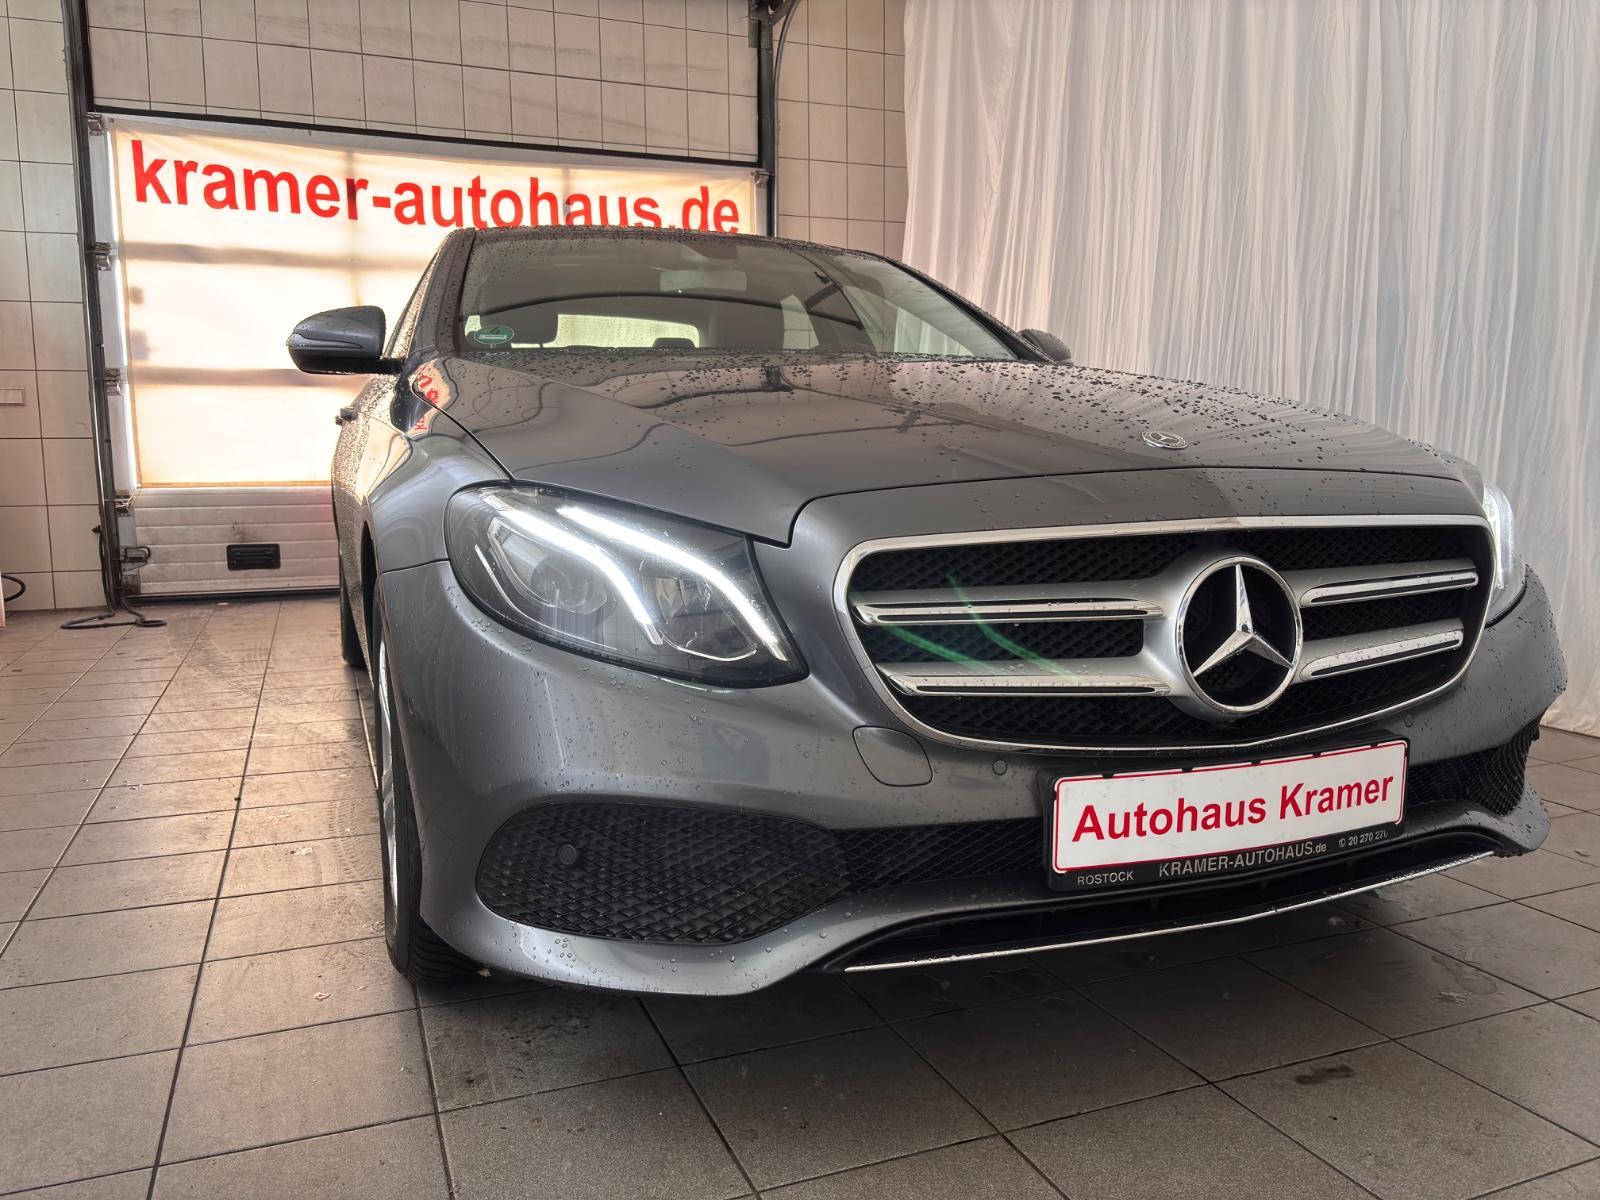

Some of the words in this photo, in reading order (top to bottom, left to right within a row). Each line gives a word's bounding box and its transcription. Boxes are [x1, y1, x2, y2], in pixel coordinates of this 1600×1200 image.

[131, 139, 739, 234] kramer-autohaus.de
[1072, 797, 1266, 843] Autohaus
[1279, 775, 1394, 820] Kramer
[1077, 871, 1134, 886] ROSTOCK
[1159, 841, 1327, 877] KRAMER-AUTOHAUS.de
[1348, 835, 1358, 846] 20
[1360, 832, 1374, 844] 270
